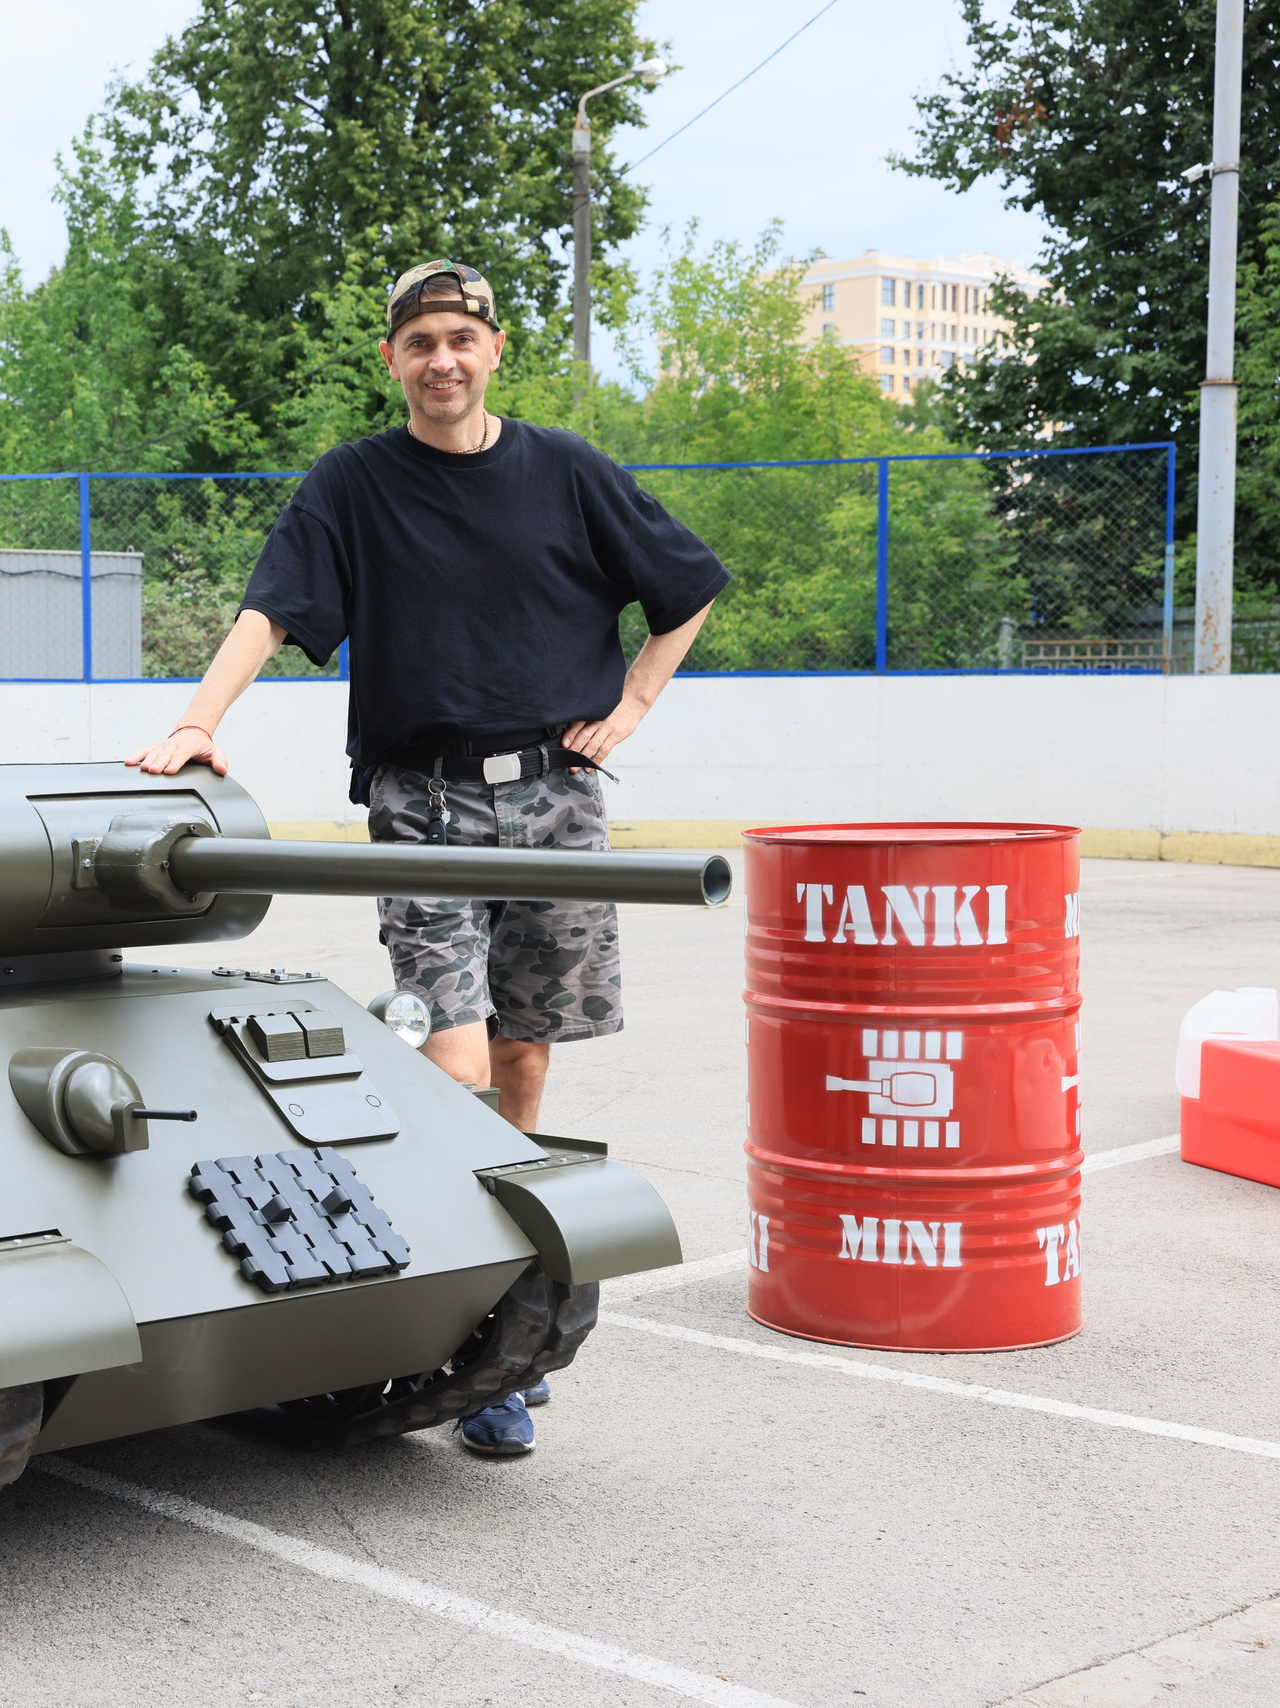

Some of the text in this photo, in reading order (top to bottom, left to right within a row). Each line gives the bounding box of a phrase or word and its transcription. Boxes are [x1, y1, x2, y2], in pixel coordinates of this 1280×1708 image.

[797, 883, 1008, 946] TANKI
[839, 1215, 962, 1267] MINI
[1037, 1217, 1081, 1287] TA
